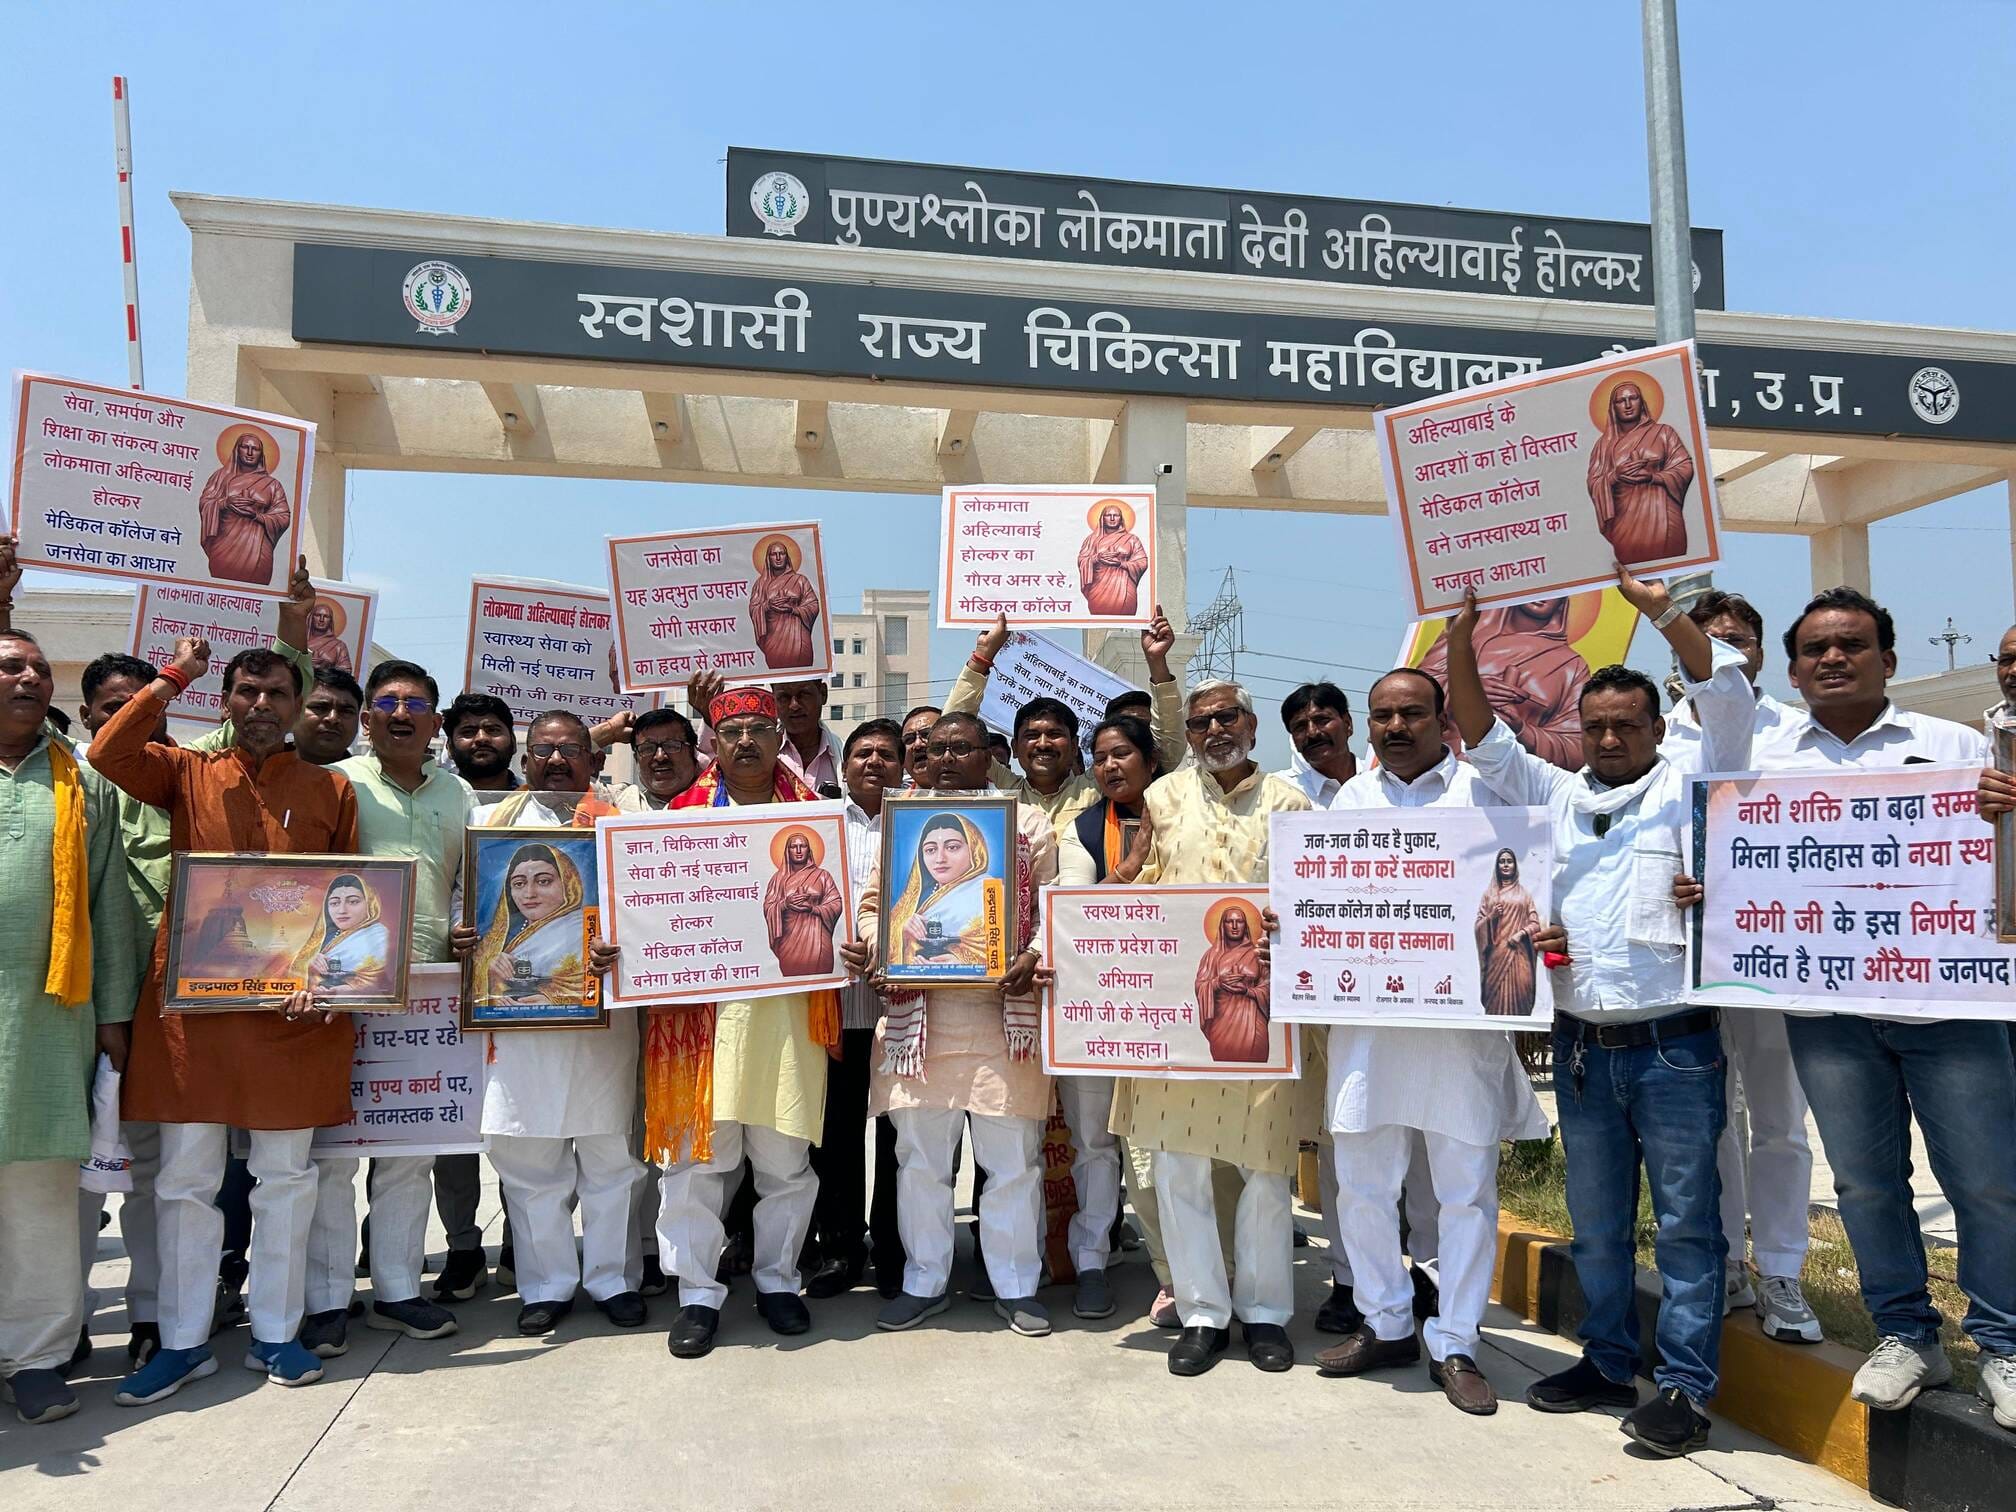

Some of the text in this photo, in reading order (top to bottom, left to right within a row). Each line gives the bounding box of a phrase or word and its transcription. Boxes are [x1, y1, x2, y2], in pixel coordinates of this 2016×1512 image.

[829, 181, 1045, 248] पुण्यश्लोका
[1057, 190, 1227, 260] लोकमाता
[1240, 203, 1309, 269] देवी
[1534, 228, 1643, 294] होल्कर
[577, 287, 812, 353] स्वशासी
[858, 313, 987, 365] राज्य
[1023, 306, 1241, 380] चिकित्सा
[104, 401, 185, 429] समर्पण और
[1408, 400, 1516, 446] अहिल्याबाई के
[42, 418, 199, 461] शिक्षा का संकल्प अपार
[1474, 449, 1496, 469] का
[1500, 440, 1518, 466] हो
[1521, 431, 1578, 460] विस्तार
[43, 449, 193, 491] लोकमाता अहिल्याबाई
[92, 486, 141, 510] होल्कर
[963, 497, 1030, 512] लोकमाता
[1420, 478, 1541, 519] मेडिकल कॉलेज
[45, 509, 182, 546] मेडिकल कॉलेज बने
[1426, 532, 1450, 557] बने
[1544, 514, 1568, 534] का
[45, 543, 176, 574] जनसेवा का आधार
[644, 545, 721, 568] जनसेवा का
[961, 546, 1034, 561] होल्कर का
[964, 571, 1002, 586] गौरव
[1006, 574, 1041, 586] अमर
[625, 580, 748, 607] यह उपहार
[959, 596, 1072, 613] मेडिकल कॉलेज
[483, 596, 524, 620] लोकमाता
[152, 613, 276, 650] होल्कर का गौरवशाली ना
[650, 615, 736, 639] योगी सरकार
[483, 631, 592, 655] स्वास्थ्य सेवा को
[481, 654, 595, 681] मिली नई पहचान
[634, 649, 756, 677] का हृदय से आभार
[486, 683, 635, 709] योगी जी का से
[1018, 684, 1033, 698] नाम
[1054, 688, 1069, 701] और
[1067, 676, 1078, 688] का
[1080, 684, 1095, 697] नाम
[1738, 791, 1925, 826] नारी शक्ति का बढ़ा
[663, 832, 748, 851] चिकित्सा और
[1304, 834, 1350, 849] जन-जन
[1353, 829, 1369, 849] की
[1371, 833, 1390, 848] यह
[1392, 828, 1401, 848] है
[1732, 834, 1951, 872] मिला इतिहास को नया
[628, 859, 748, 880] सेवा की नई पहचान
[1294, 855, 1399, 878] योगी जी का करें
[624, 889, 684, 908] लोकमाता
[1295, 900, 1336, 918] मेडिकल
[1338, 900, 1373, 918] कॉलेज
[1375, 900, 1390, 918] को
[1393, 900, 1410, 920] नई
[670, 914, 714, 932] होल्कर
[1083, 905, 1121, 920] स्वस्थ
[1735, 901, 1785, 933] योगी
[1794, 901, 1823, 933] जी
[1832, 901, 1856, 934] के
[1865, 910, 1900, 939] इस
[1910, 901, 1976, 935] निर्णय
[1074, 933, 1178, 955] सशक्त प्रदेश का
[1301, 925, 1342, 948] औरैया
[1345, 932, 1365, 949] का
[642, 939, 743, 960] मेडिकल कॉलेज
[632, 964, 760, 988] बनेगा प्रदेश की शान
[1098, 967, 1153, 989] अभियान
[1733, 945, 1930, 991] गर्वित है पूरा औरैया
[242, 979, 266, 991] सिंह
[270, 982, 295, 991] पाल
[1063, 1000, 1193, 1029] योगी जी के नेतृत्व में
[373, 1028, 429, 1047] घर-घर
[1086, 1036, 1121, 1058] प्रदेश
[369, 1080, 402, 1103] पुण्य
[408, 1070, 441, 1094] कार्य
[363, 1107, 434, 1125] नतमस्तक
